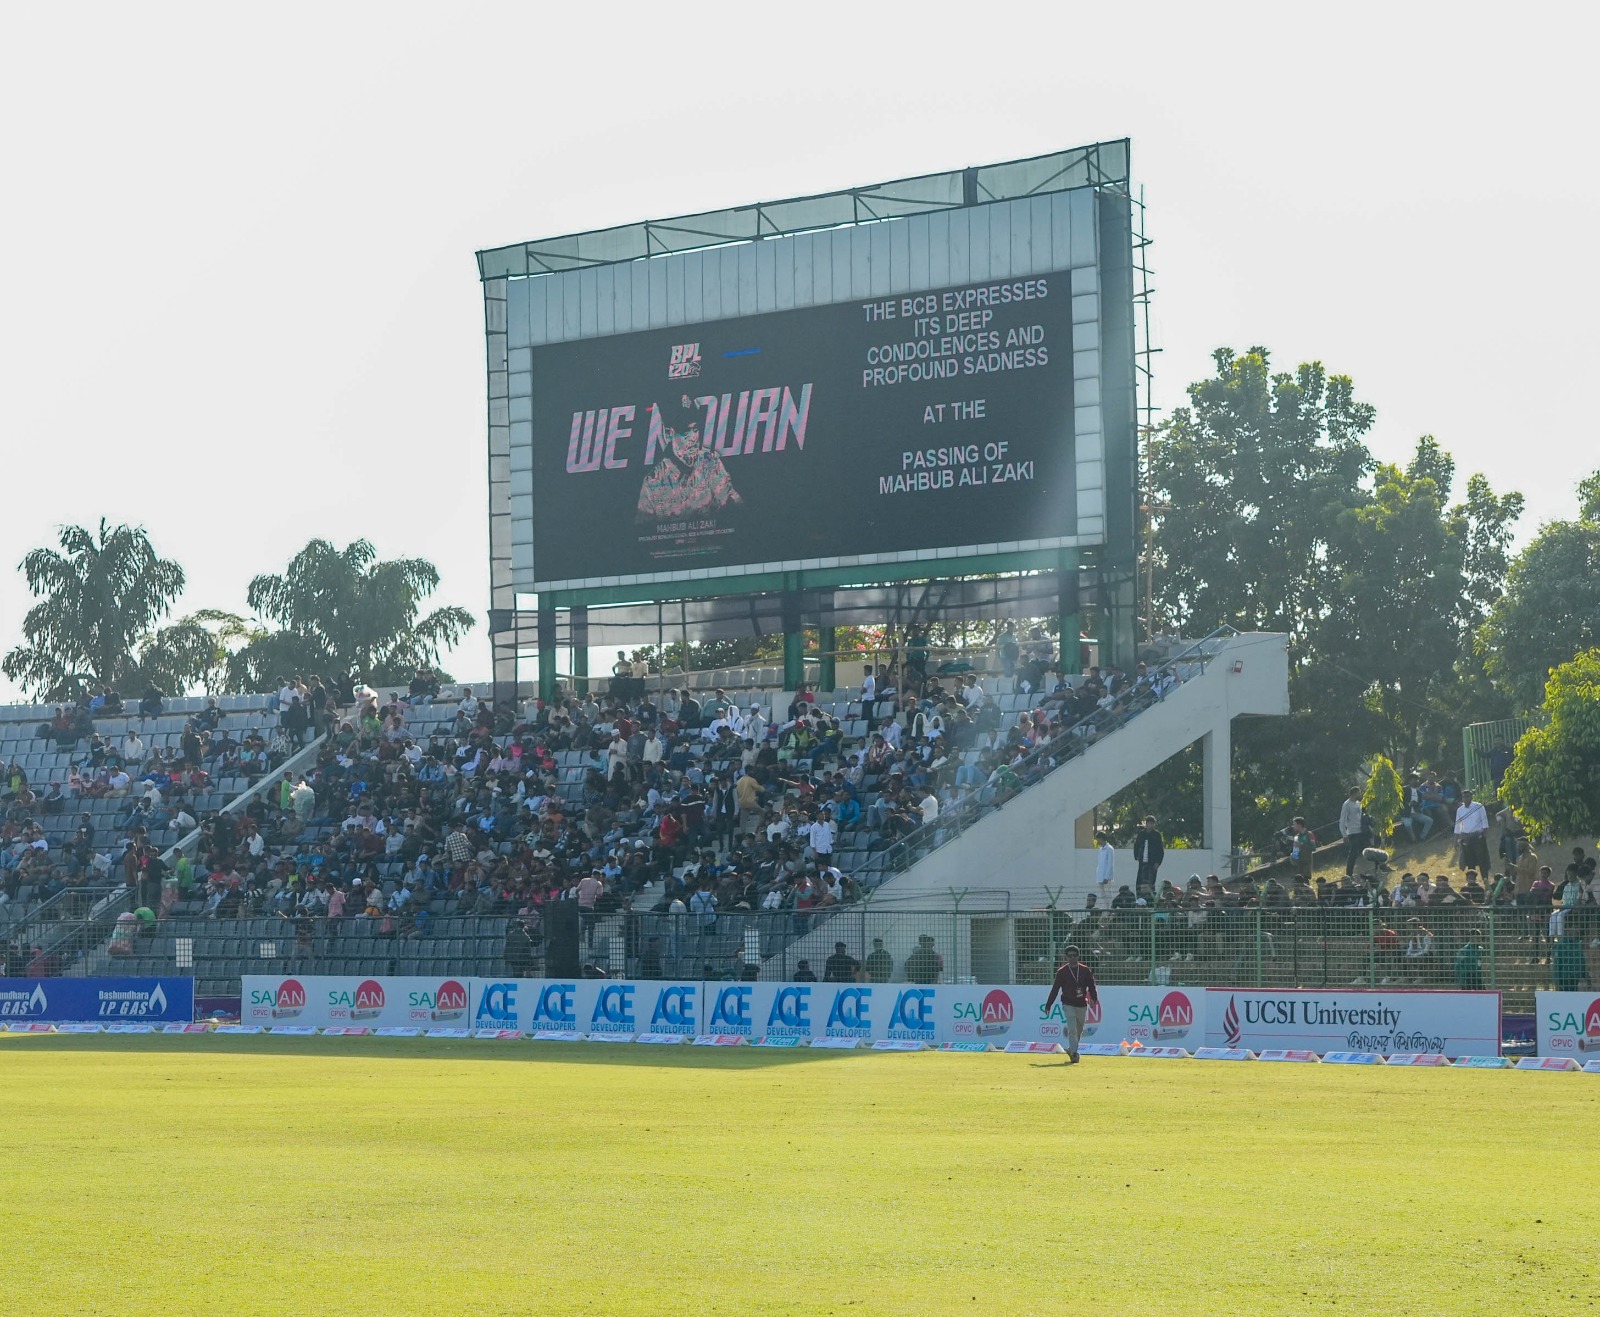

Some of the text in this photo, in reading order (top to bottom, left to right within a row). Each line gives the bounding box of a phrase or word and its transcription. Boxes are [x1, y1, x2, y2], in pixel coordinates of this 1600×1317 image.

[862, 279, 1048, 322] THE BCB EXPRESSES
[914, 310, 993, 338] ITS DEEP
[670, 343, 701, 364] BPL
[867, 324, 1044, 364] CONDOLENCES AND
[863, 346, 1048, 388] PROFOUND SADNESS
[924, 399, 986, 424] AT THE
[566, 405, 636, 474] WE
[902, 441, 1008, 470] PASSING OF
[879, 460, 1034, 494] MAHBUB ALI ZAKI
[98, 990, 149, 1000] Bashundhara
[250, 990, 304, 1006] SAJAN
[328, 991, 383, 1008] SAJAN
[408, 992, 465, 1009] SAJAN
[476, 984, 518, 1020] ACE
[533, 984, 576, 1022] ACE
[591, 985, 636, 1024] ACE
[1, 1001, 29, 1015] GAS
[98, 1001, 148, 1015] LP GAS
[410, 1011, 427, 1019] CPVC
[651, 986, 696, 1025] ACE
[710, 986, 752, 1026] ACE
[767, 987, 811, 1027] ACE
[827, 988, 872, 1028] ACE
[888, 989, 936, 1030] ACE
[953, 1002, 1011, 1022] SAJAN
[1128, 1005, 1190, 1025] SAJAN
[476, 1020, 518, 1030] DEVELOPERS
[532, 1022, 576, 1031] DEVELOPERS
[1244, 1000, 1402, 1034] UCSI University
[591, 1024, 636, 1032] DEVELOPERS
[650, 1025, 695, 1034] DEVELOPERS
[710, 1026, 752, 1036] DEVELOPERS
[766, 1026, 811, 1036] DEVELOPERS
[826, 1028, 872, 1038] DEVELOPERS
[888, 1029, 935, 1040] DEVELOPERS
[955, 1024, 972, 1032] CPVC
[1042, 1026, 1058, 1034] CPVC
[1130, 1028, 1148, 1036] CPVC
[1552, 1038, 1573, 1047] CPVC
